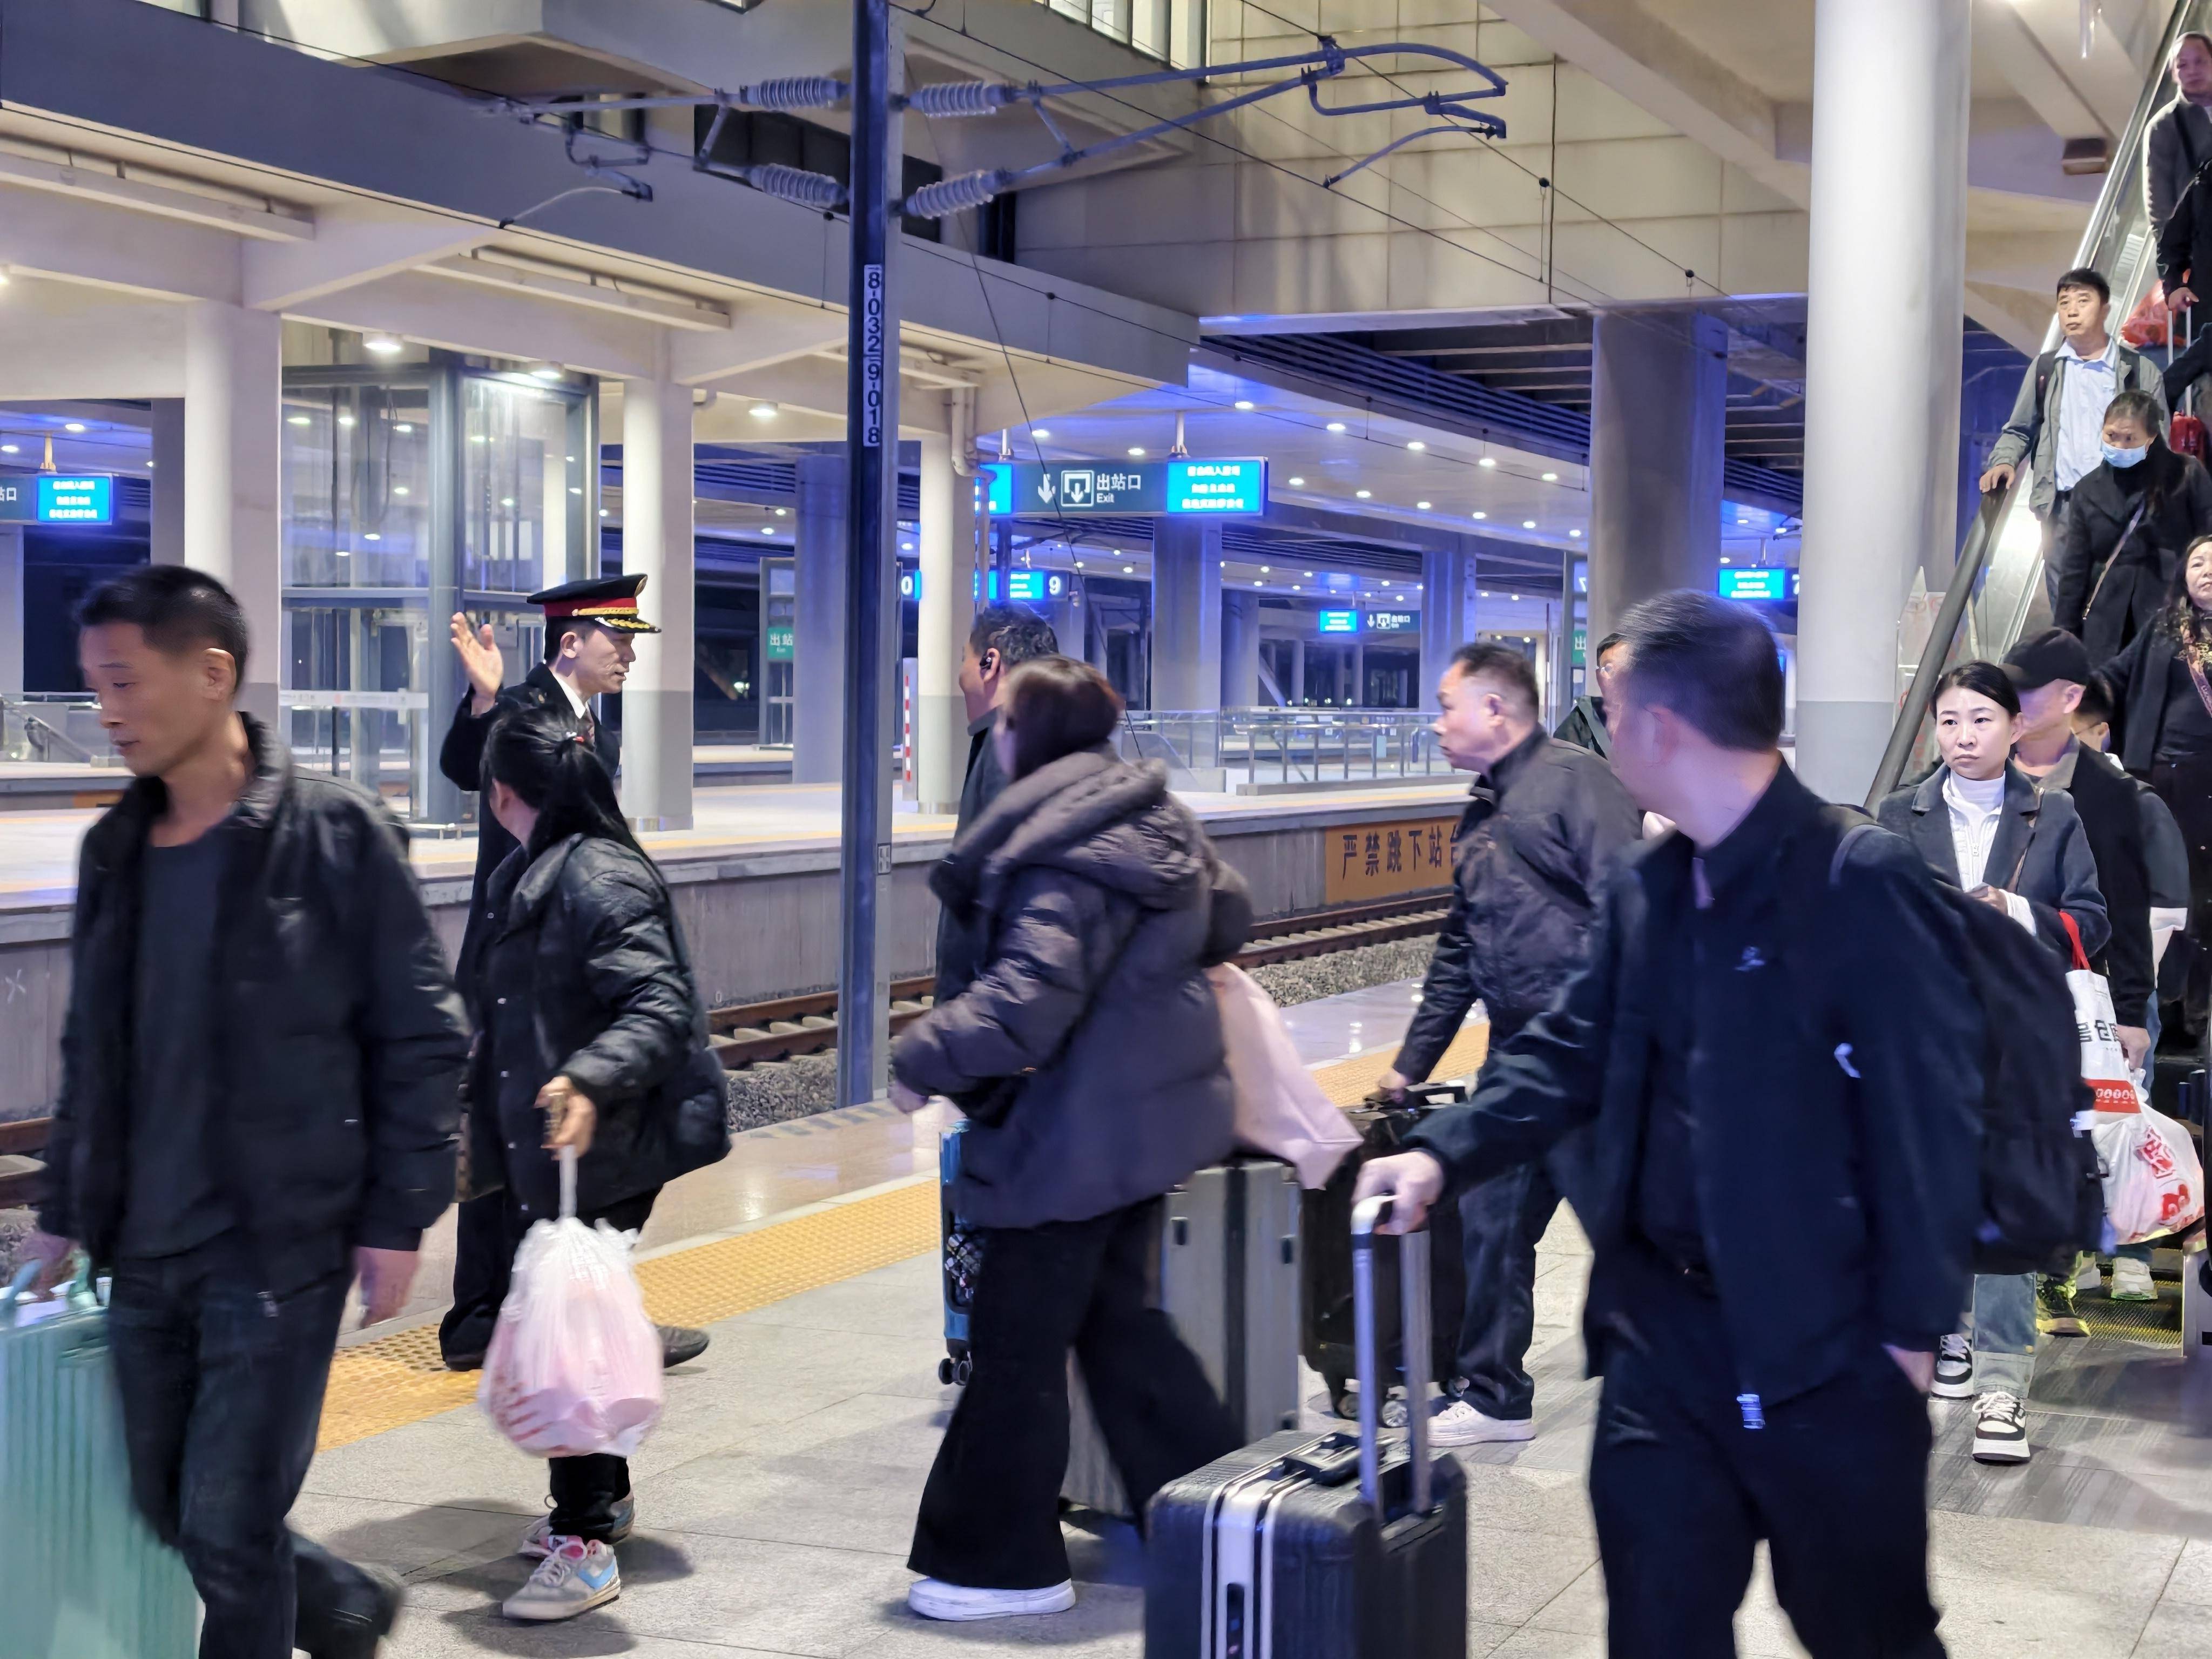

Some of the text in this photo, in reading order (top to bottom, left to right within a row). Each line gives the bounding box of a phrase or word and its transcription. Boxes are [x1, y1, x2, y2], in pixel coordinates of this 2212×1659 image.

[1097, 473, 1141, 491] 出站口
[1097, 493, 1115, 503] Exit
[1049, 576, 1061, 595] 9
[770, 633, 793, 646] 出站
